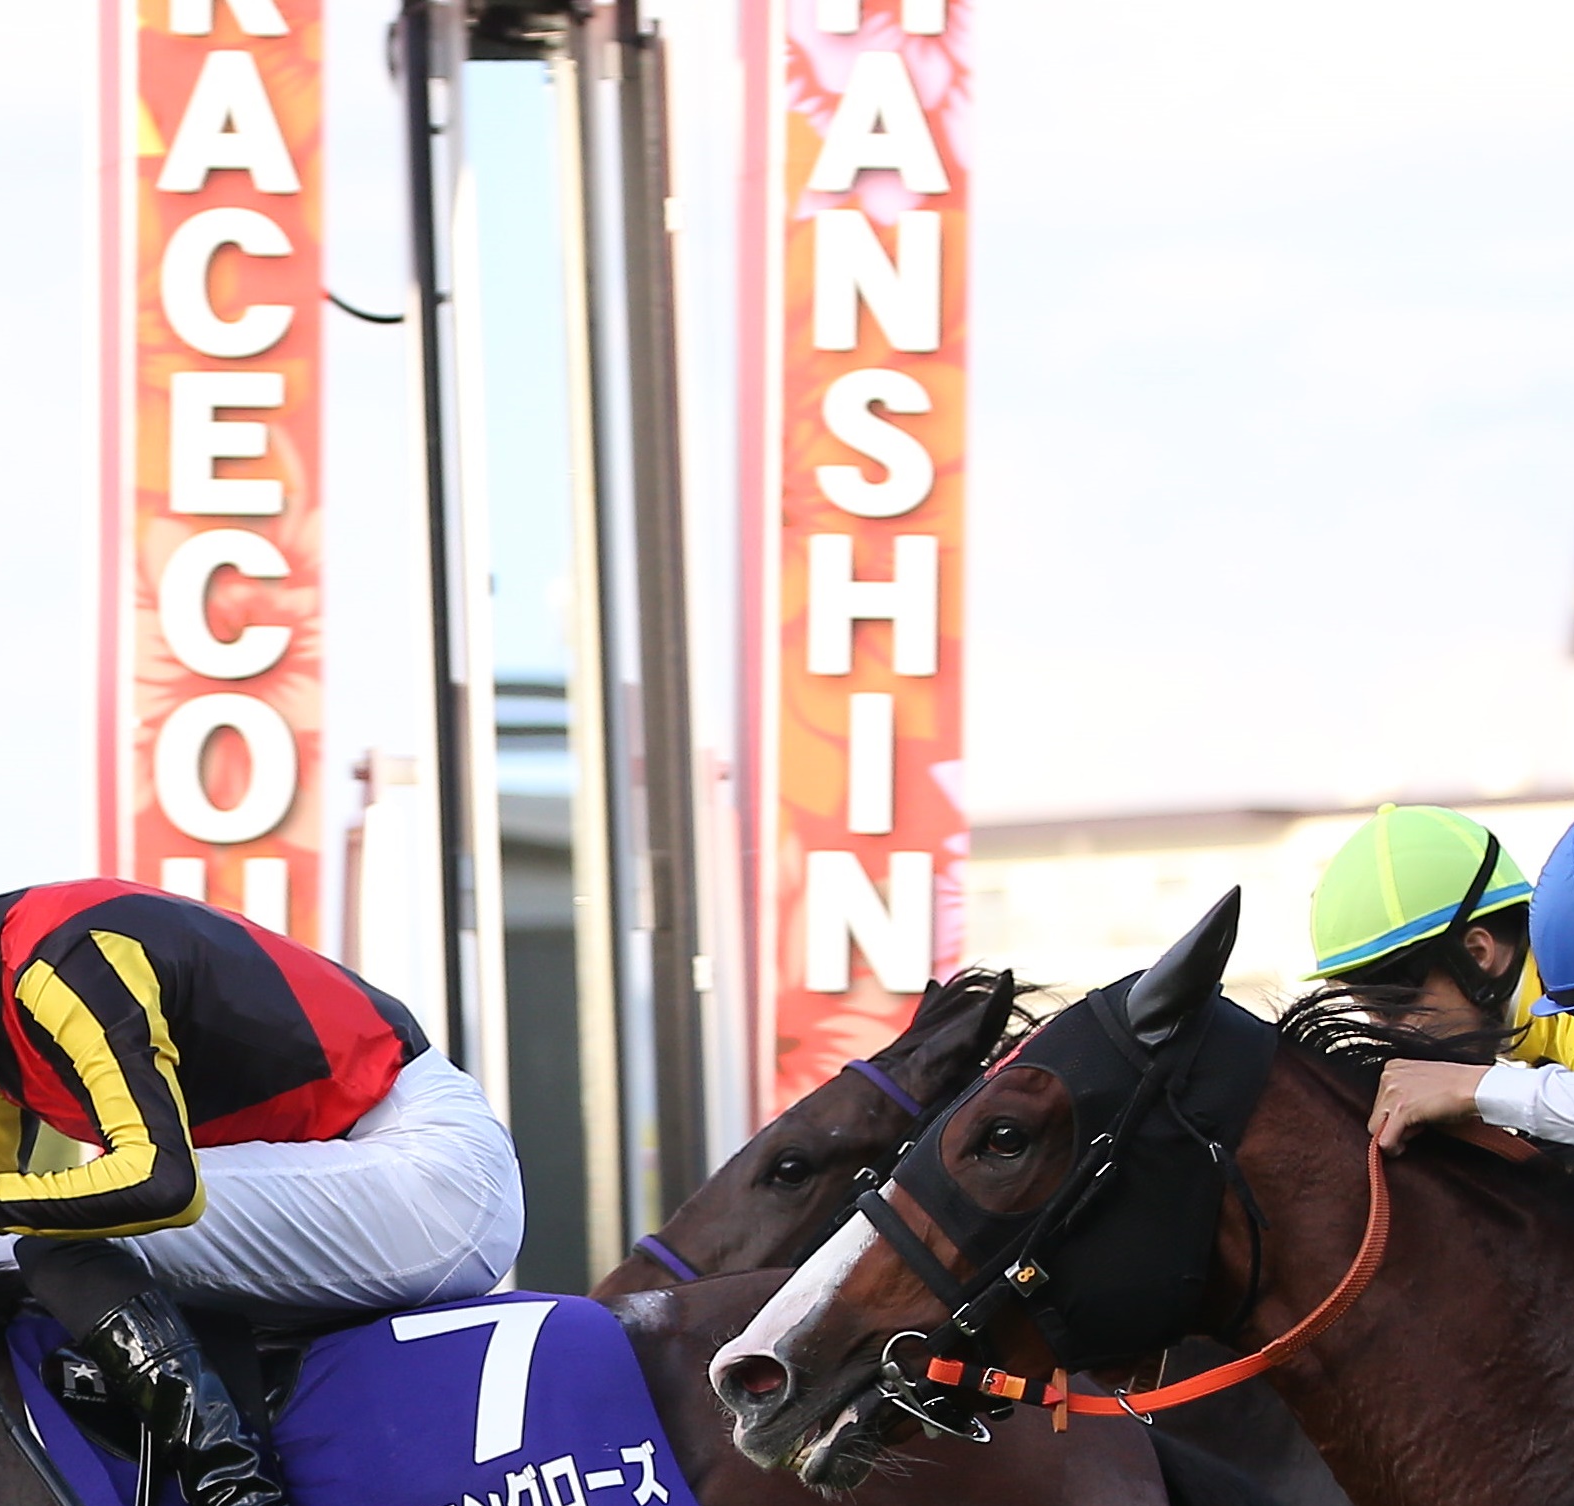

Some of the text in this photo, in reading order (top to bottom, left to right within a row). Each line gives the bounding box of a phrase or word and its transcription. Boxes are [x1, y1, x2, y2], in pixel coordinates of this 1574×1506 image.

[154, 0, 301, 937] ACECO
[807, 0, 950, 993] ANSHIN
[391, 1299, 559, 1466] 7
[1017, 1266, 1035, 1282] 8
